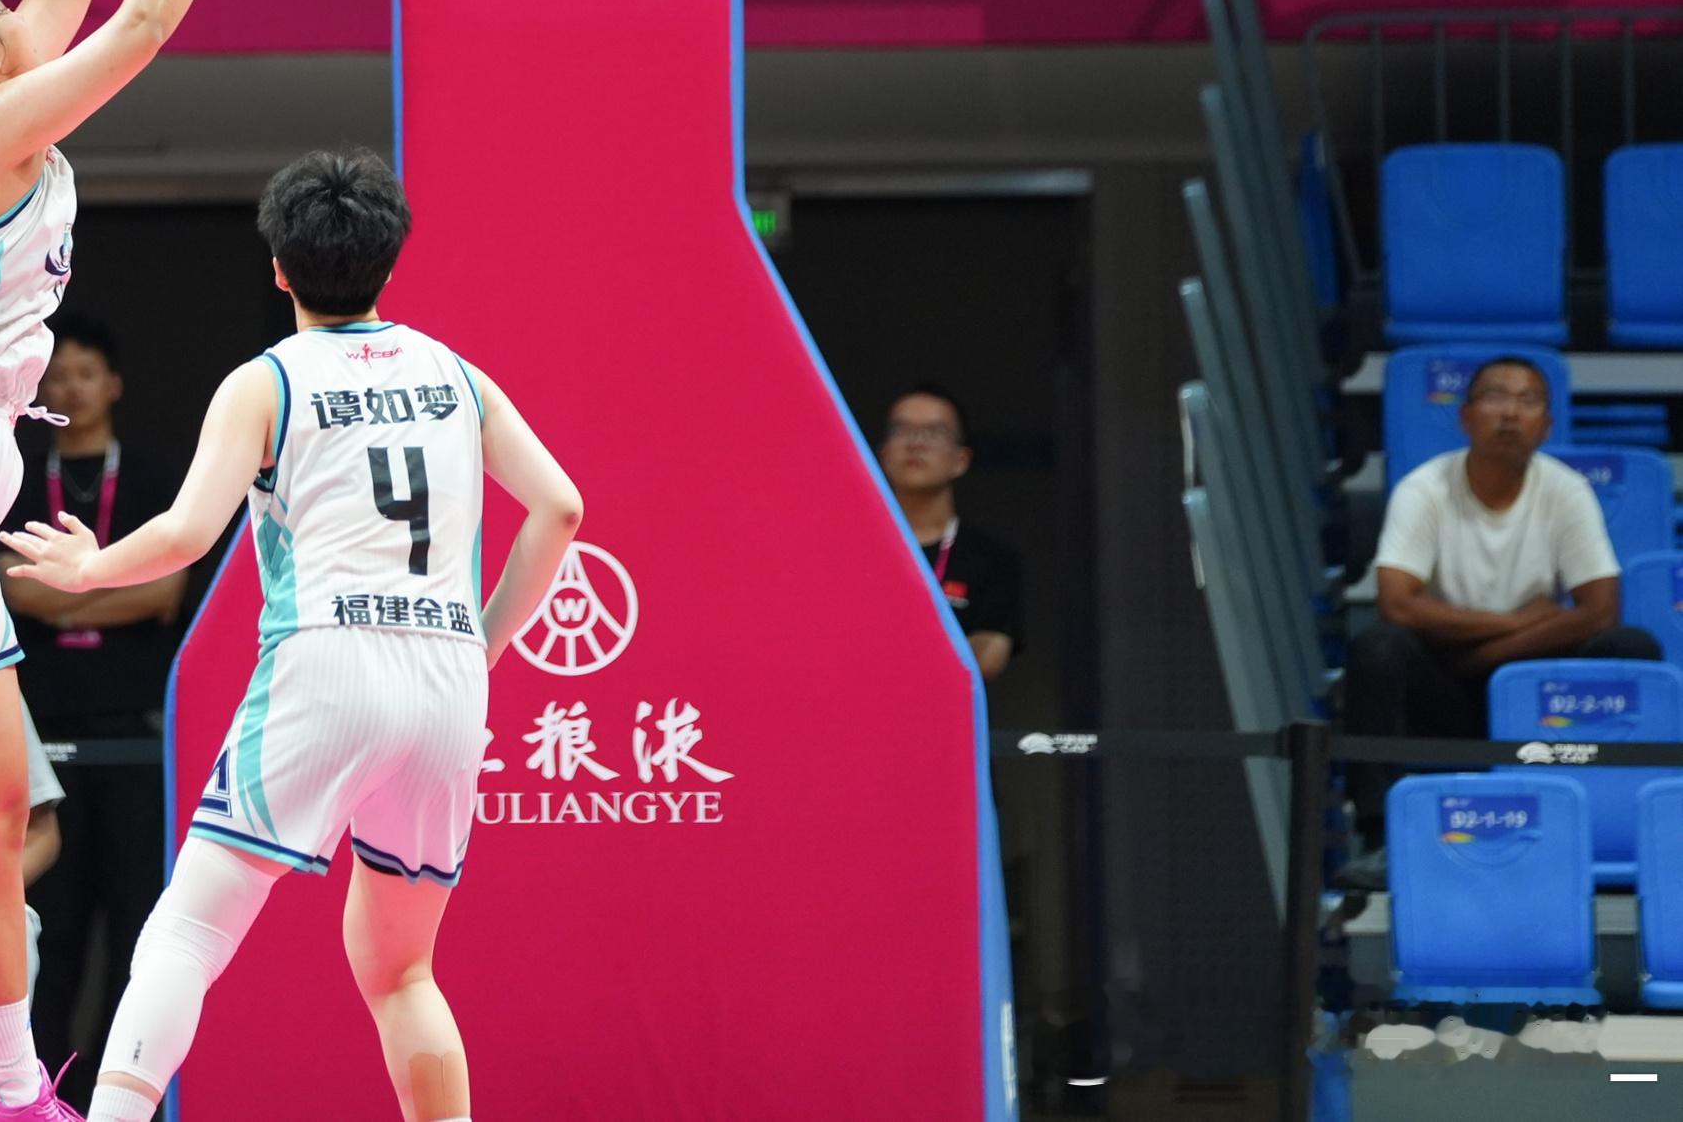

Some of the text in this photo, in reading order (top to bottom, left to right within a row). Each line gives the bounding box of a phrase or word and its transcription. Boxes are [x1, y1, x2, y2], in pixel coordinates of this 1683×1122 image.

[310, 383, 460, 430] 谭如梦
[367, 445, 432, 577] 4
[331, 593, 475, 636] 福建金篮
[475, 790, 724, 825] ULIANGYE
